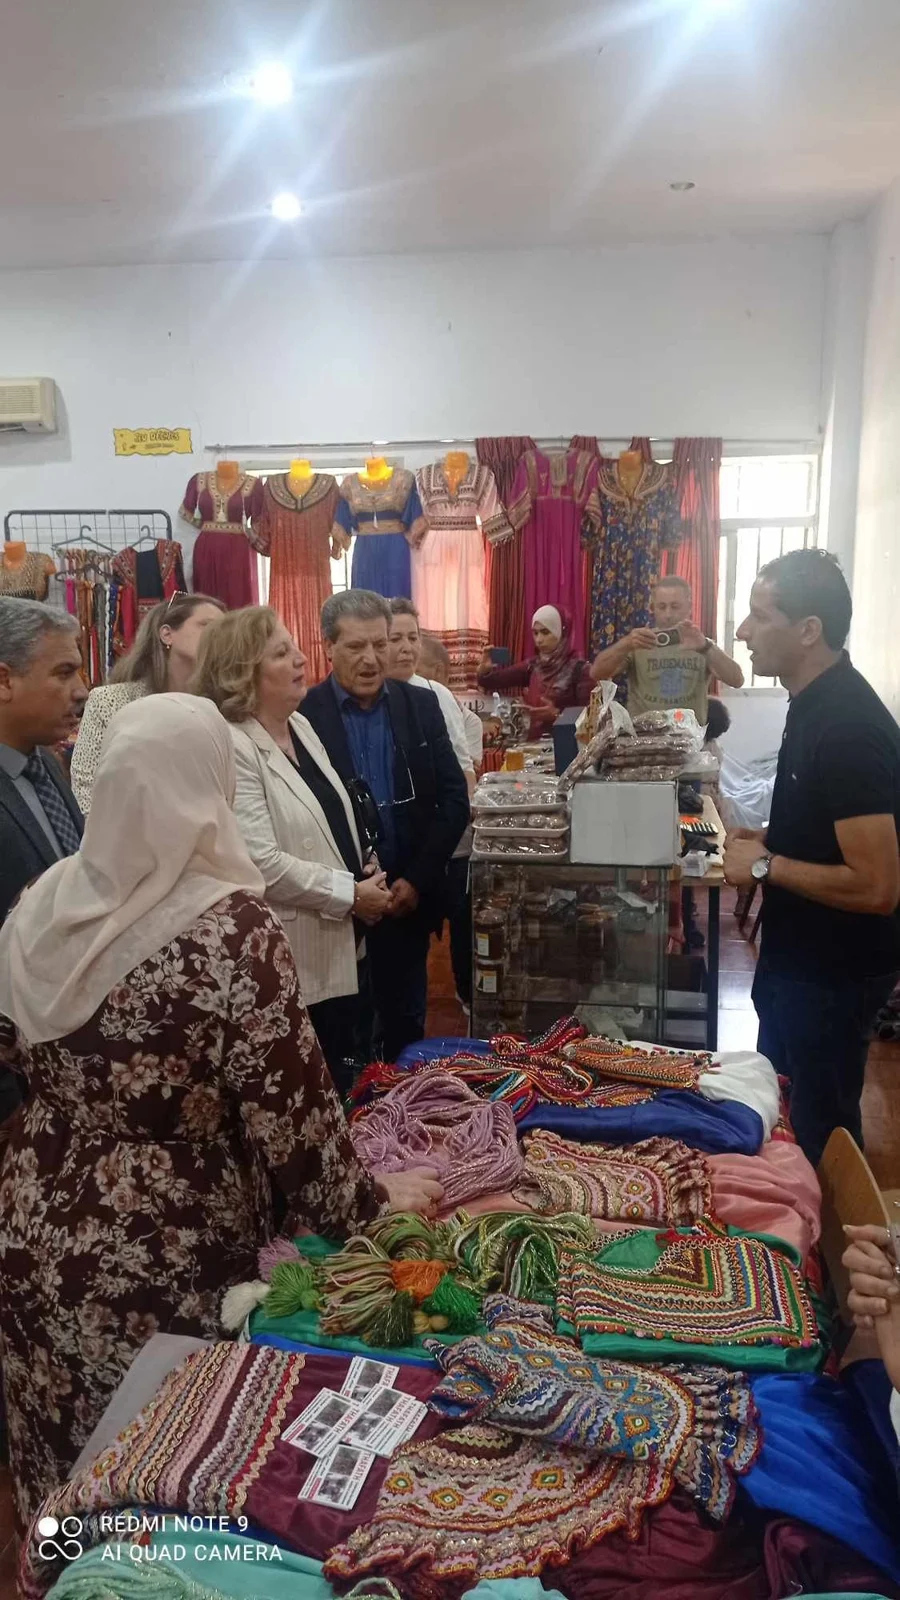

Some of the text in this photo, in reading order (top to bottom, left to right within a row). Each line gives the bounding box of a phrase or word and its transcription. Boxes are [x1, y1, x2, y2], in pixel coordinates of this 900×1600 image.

[647, 657, 700, 671] TRADEMARK
[333, 1406, 360, 1434] THAFATH
[386, 1395, 411, 1423] THAFATH
[393, 1401, 417, 1429] THAFATH
[352, 1451, 372, 1481] THAFATH
